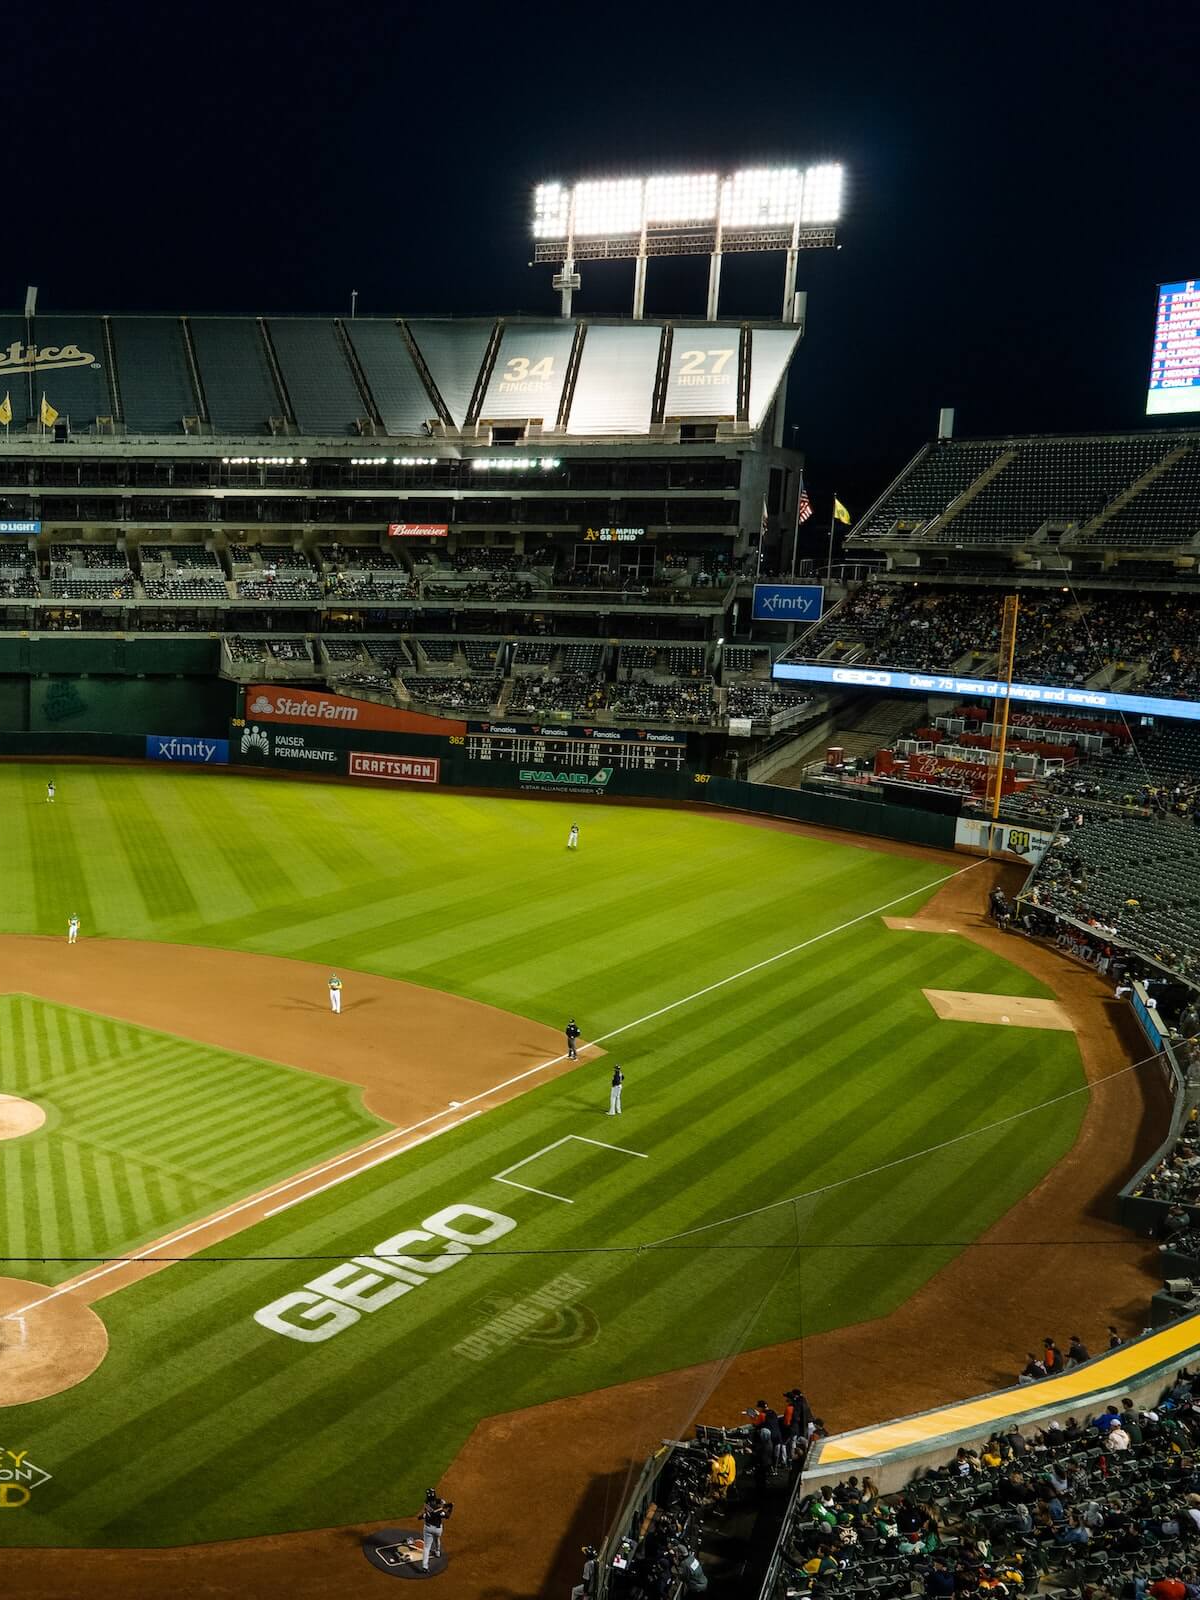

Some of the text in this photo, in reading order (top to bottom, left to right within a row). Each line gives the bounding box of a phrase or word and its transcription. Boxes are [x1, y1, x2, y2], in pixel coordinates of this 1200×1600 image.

[680, 350, 735, 375] 27
[503, 357, 555, 382] 34
[678, 375, 730, 385] HUNTER
[499, 382, 552, 393] FINGERS
[7, 523, 35, 531] LIGHT
[392, 524, 446, 536] Budweiser
[762, 595, 813, 613] xfinity
[833, 669, 891, 685] GEICO
[910, 675, 936, 688] Over
[938, 678, 953, 690] 75
[955, 681, 984, 694] years
[986, 682, 998, 694] of
[1043, 689, 1065, 701] and
[1067, 692, 1107, 705] service
[274, 698, 358, 721] State Farm
[490, 726, 516, 735] Fanatics
[541, 728, 568, 737] Fanatics
[594, 730, 620, 740] Fanatics
[275, 735, 304, 747] KAISER
[449, 736, 465, 745] 362
[647, 733, 674, 742] Fanatics
[159, 739, 217, 761] xfinity
[275, 748, 335, 761] PERMANENTE
[355, 758, 432, 777] CRAFTSMAN
[519, 770, 555, 782] EVA
[694, 774, 711, 783] 367
[1009, 830, 1029, 847] 811
[253, 1203, 518, 1343] GEICO
